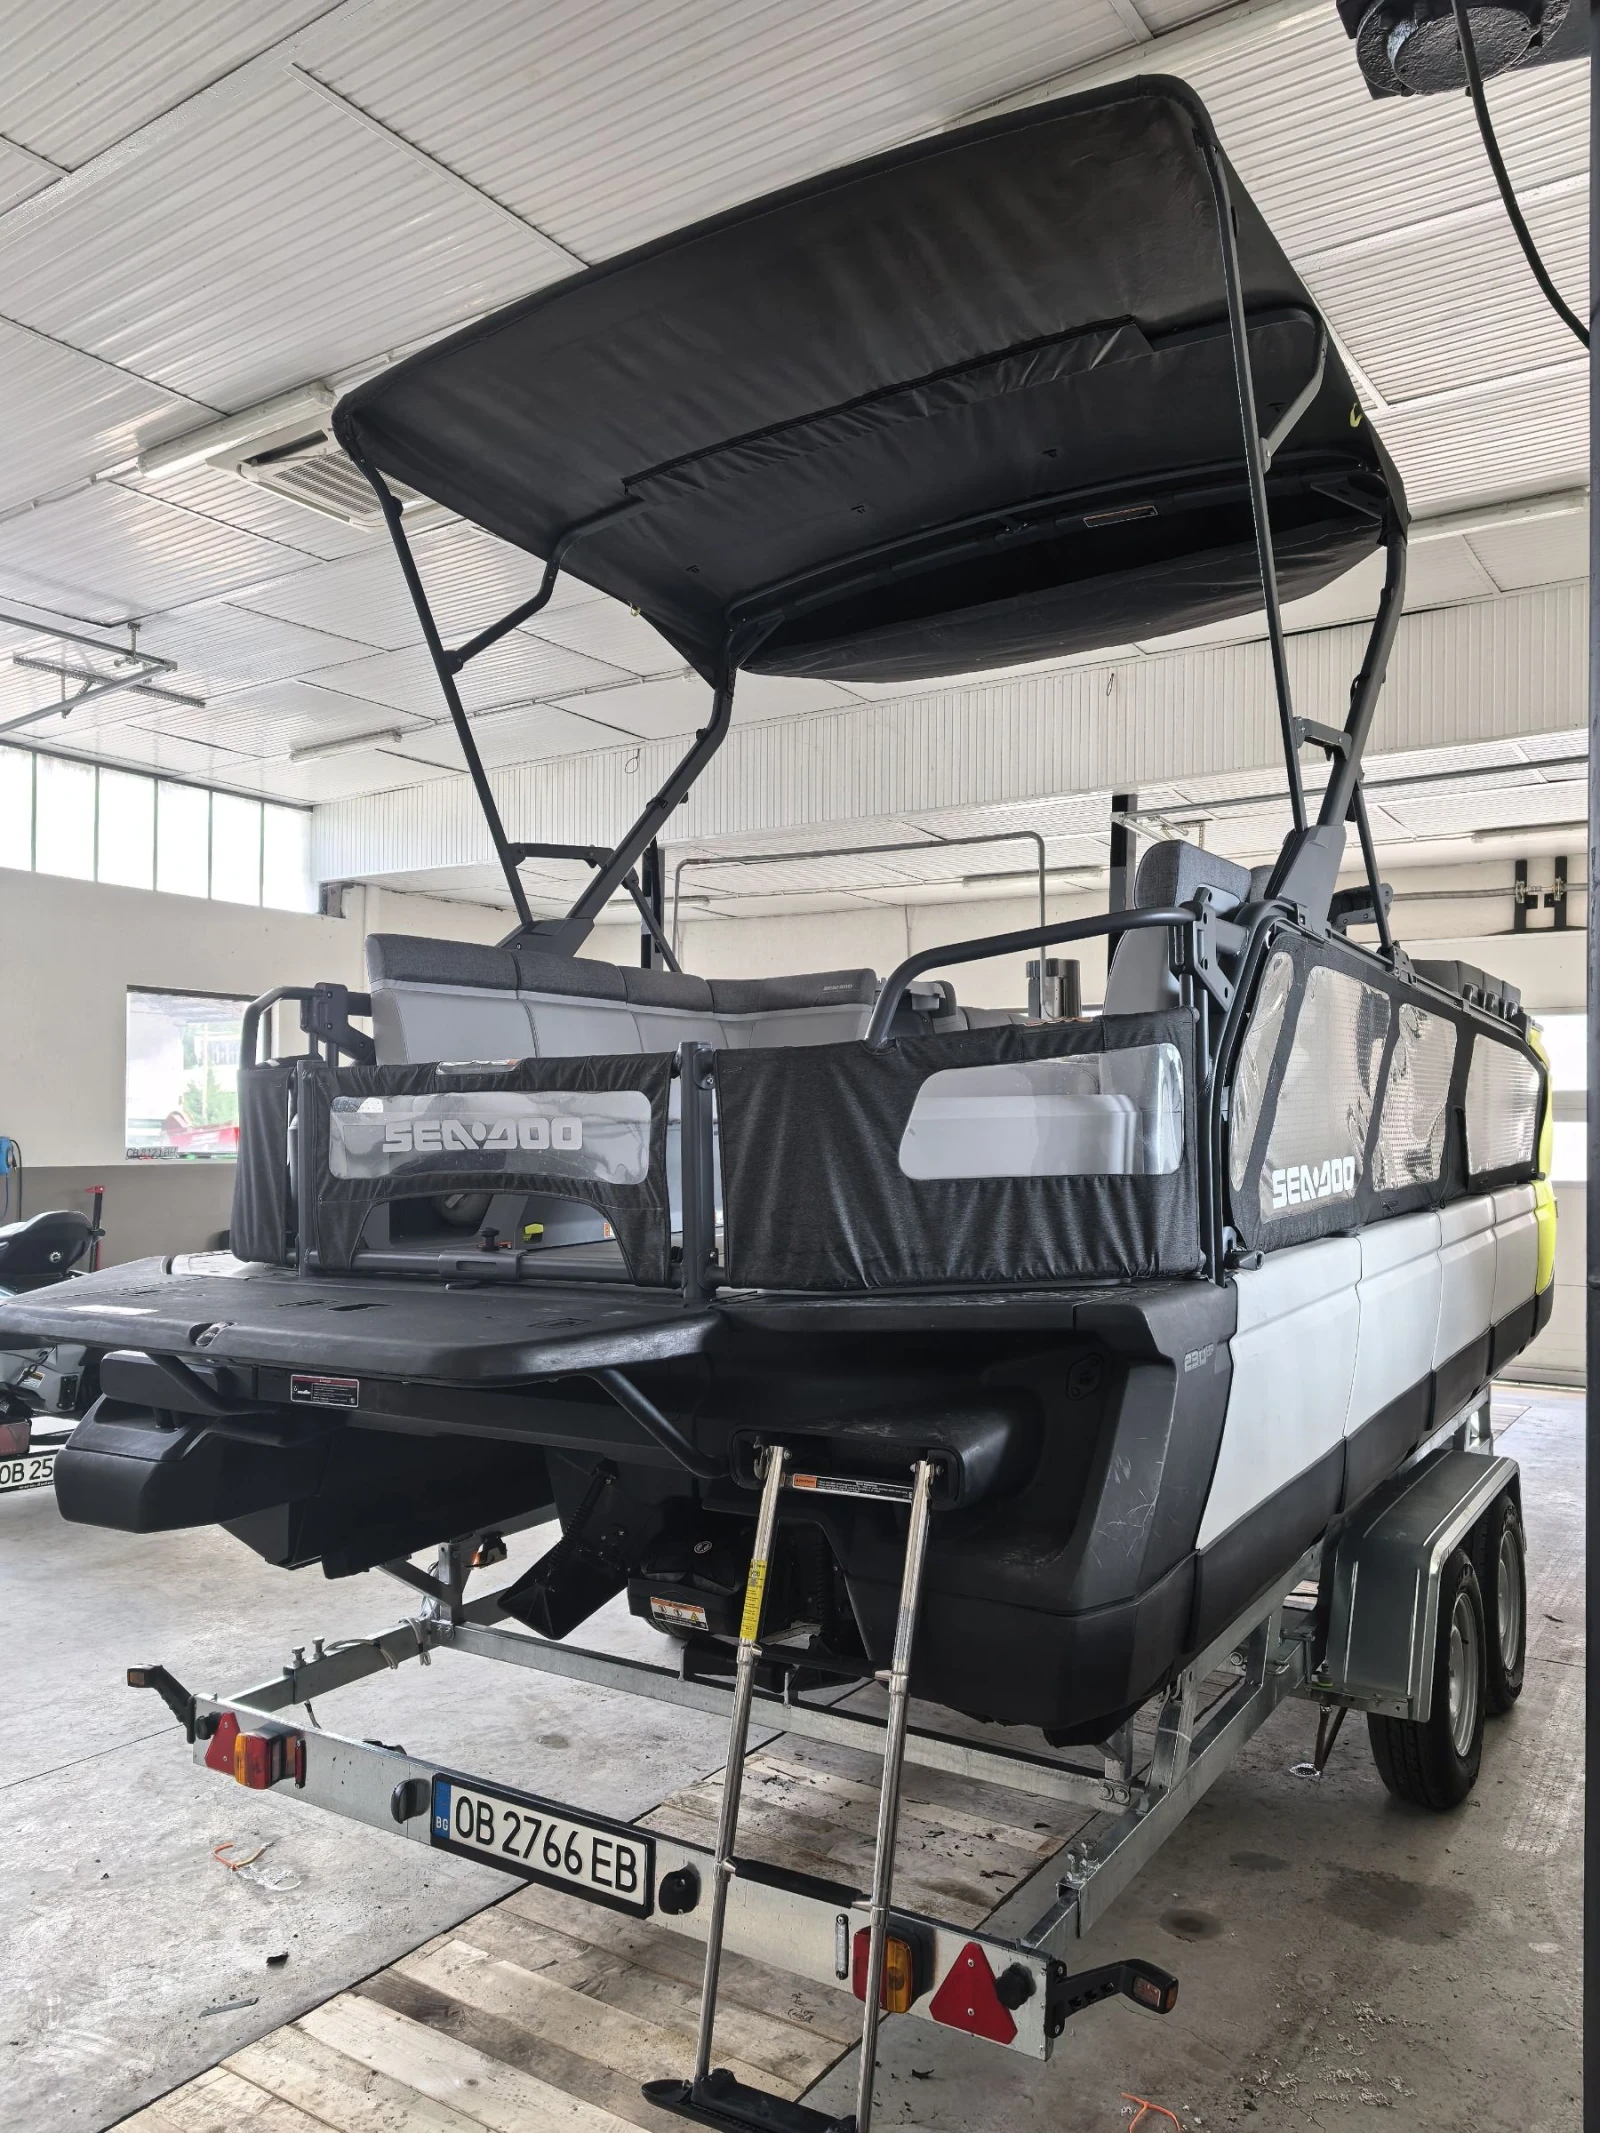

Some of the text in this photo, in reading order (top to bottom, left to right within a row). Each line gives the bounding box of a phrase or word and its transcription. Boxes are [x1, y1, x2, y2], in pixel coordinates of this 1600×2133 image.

[0, 1463, 24, 1485] OB
[436, 1816, 448, 1831] BG
[455, 1796, 637, 1893] OB 2766 EB
